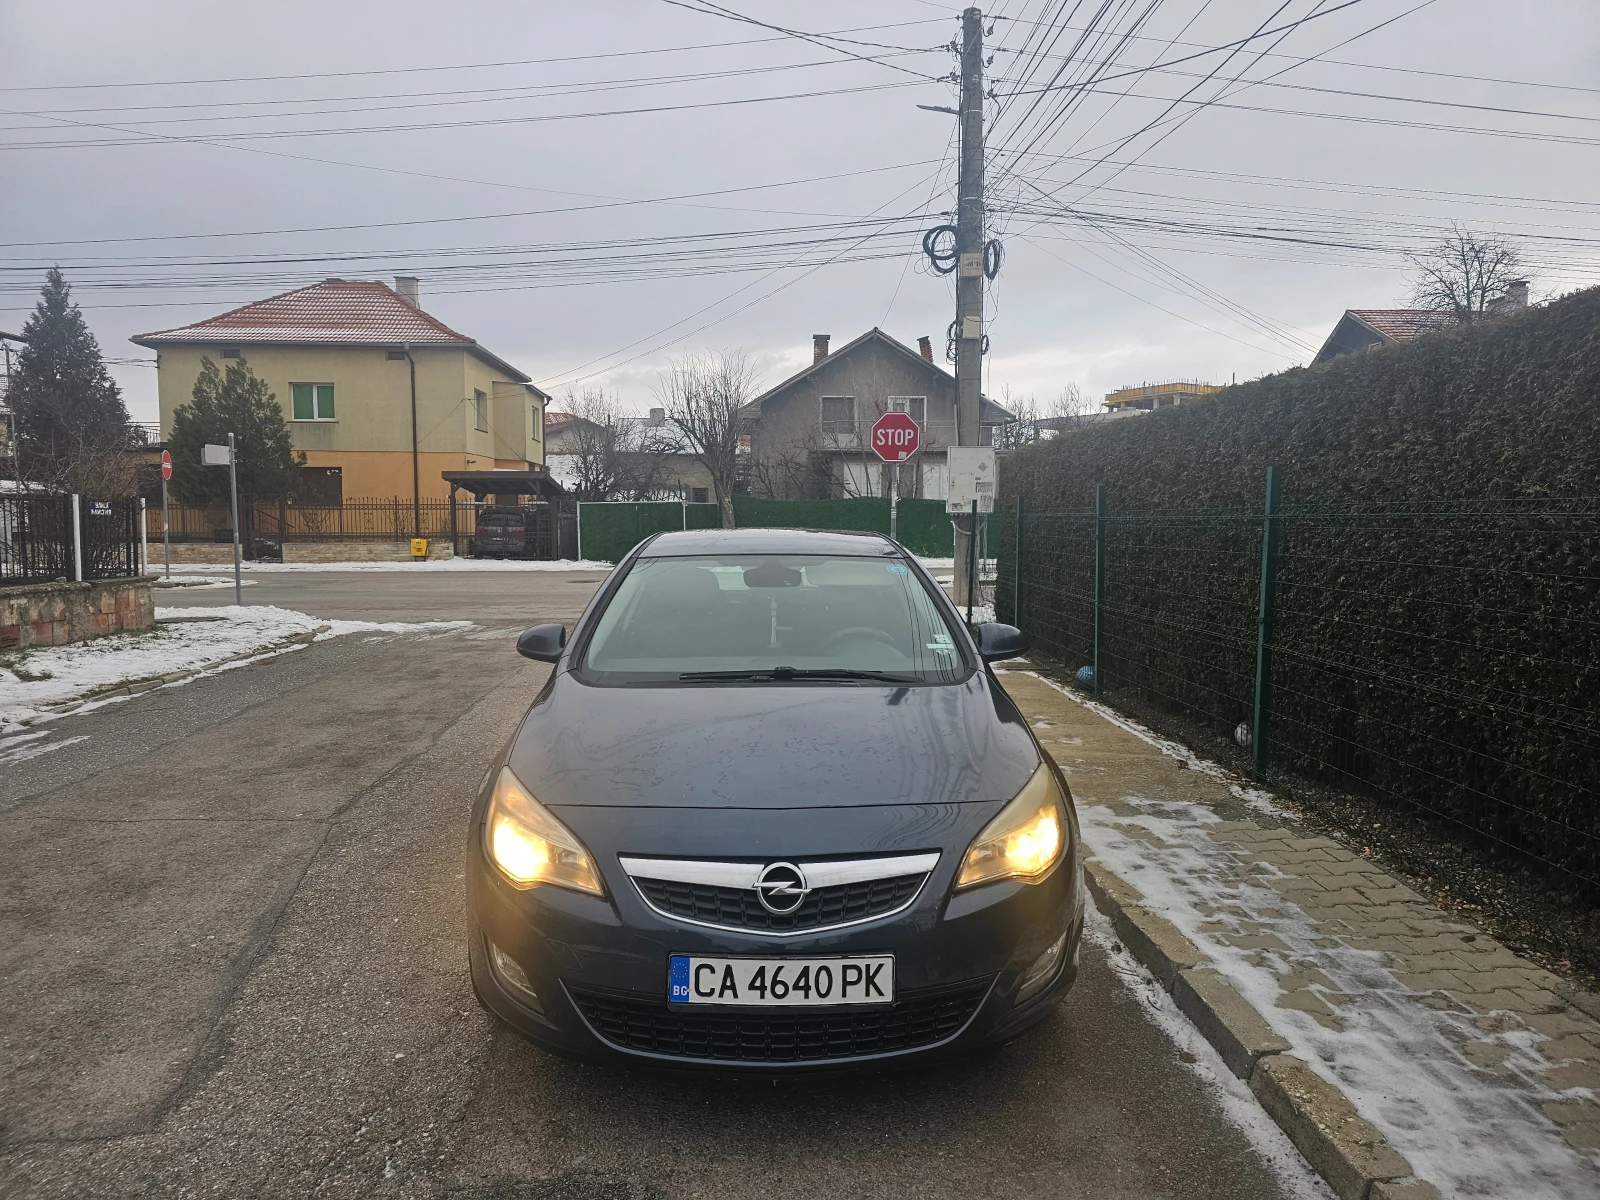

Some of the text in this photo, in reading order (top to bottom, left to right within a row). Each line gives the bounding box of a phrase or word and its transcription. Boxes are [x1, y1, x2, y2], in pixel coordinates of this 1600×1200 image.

[876, 428, 914, 446] STOP
[694, 963, 885, 1000] CA 4640 PK
[672, 985, 689, 997] BG
